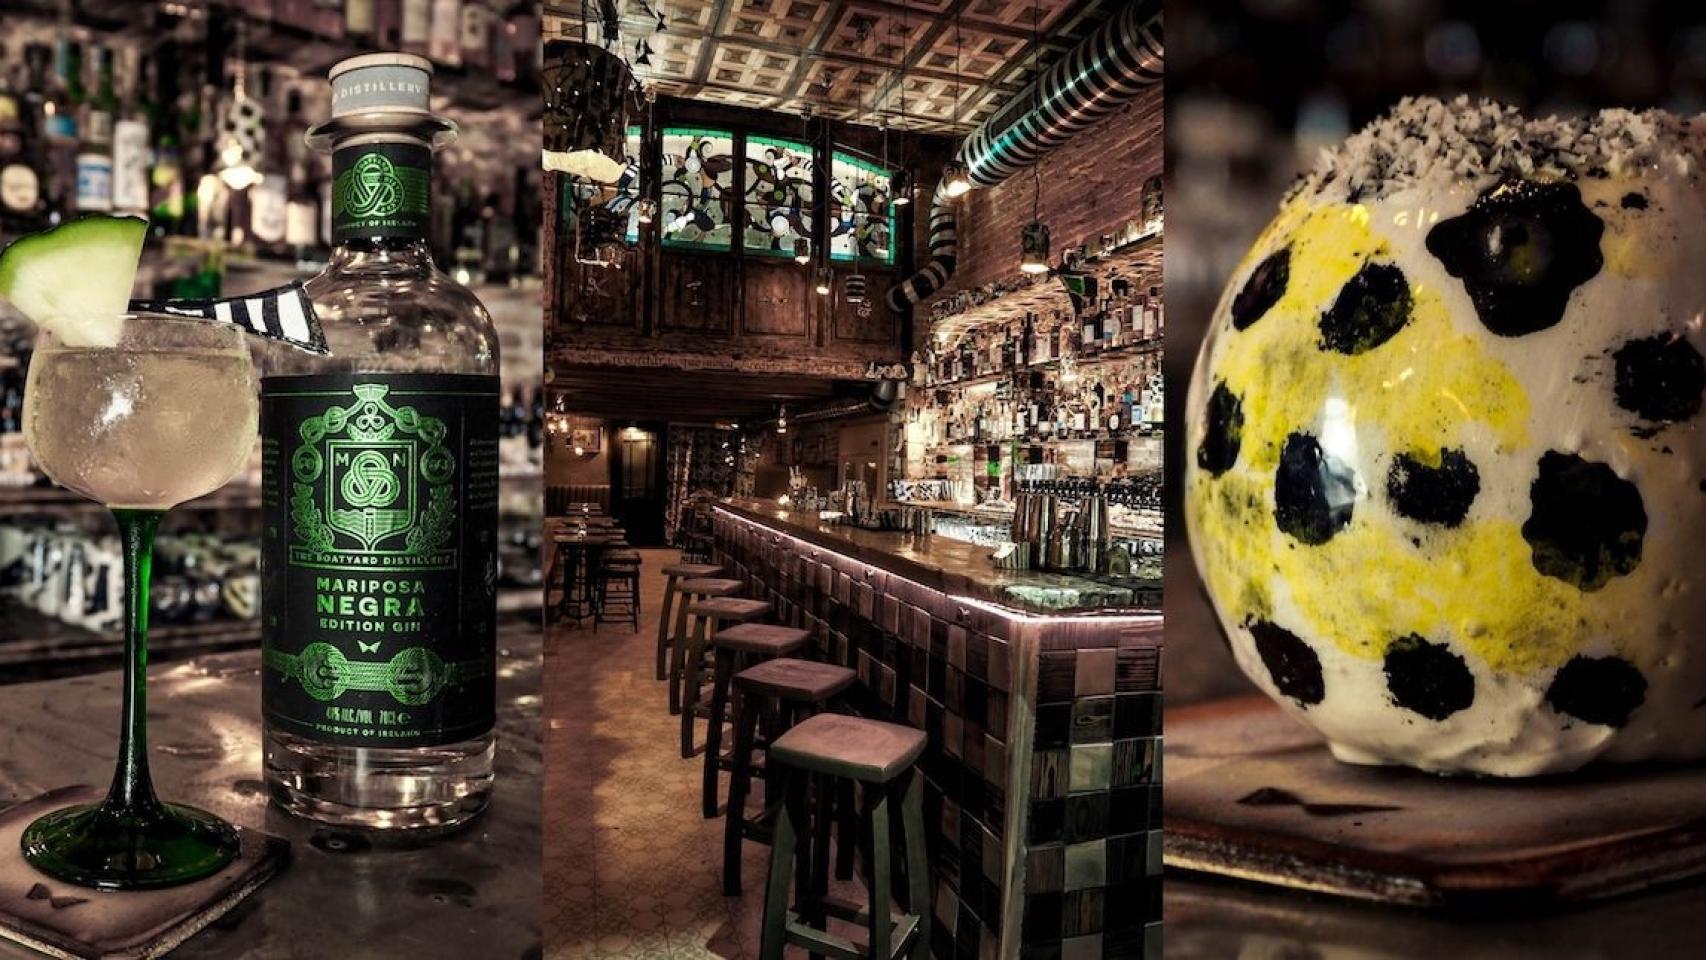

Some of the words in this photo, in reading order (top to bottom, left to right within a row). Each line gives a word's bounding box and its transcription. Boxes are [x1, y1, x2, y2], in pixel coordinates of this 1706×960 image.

[341, 81, 421, 98] DISTILLERY
[335, 452, 349, 466] M
[392, 452, 406, 467] N
[316, 577, 424, 594] MARIPOSA
[316, 594, 424, 617] NEGRA
[319, 618, 385, 632] EDITION
[316, 723, 359, 736] PRODUCT
